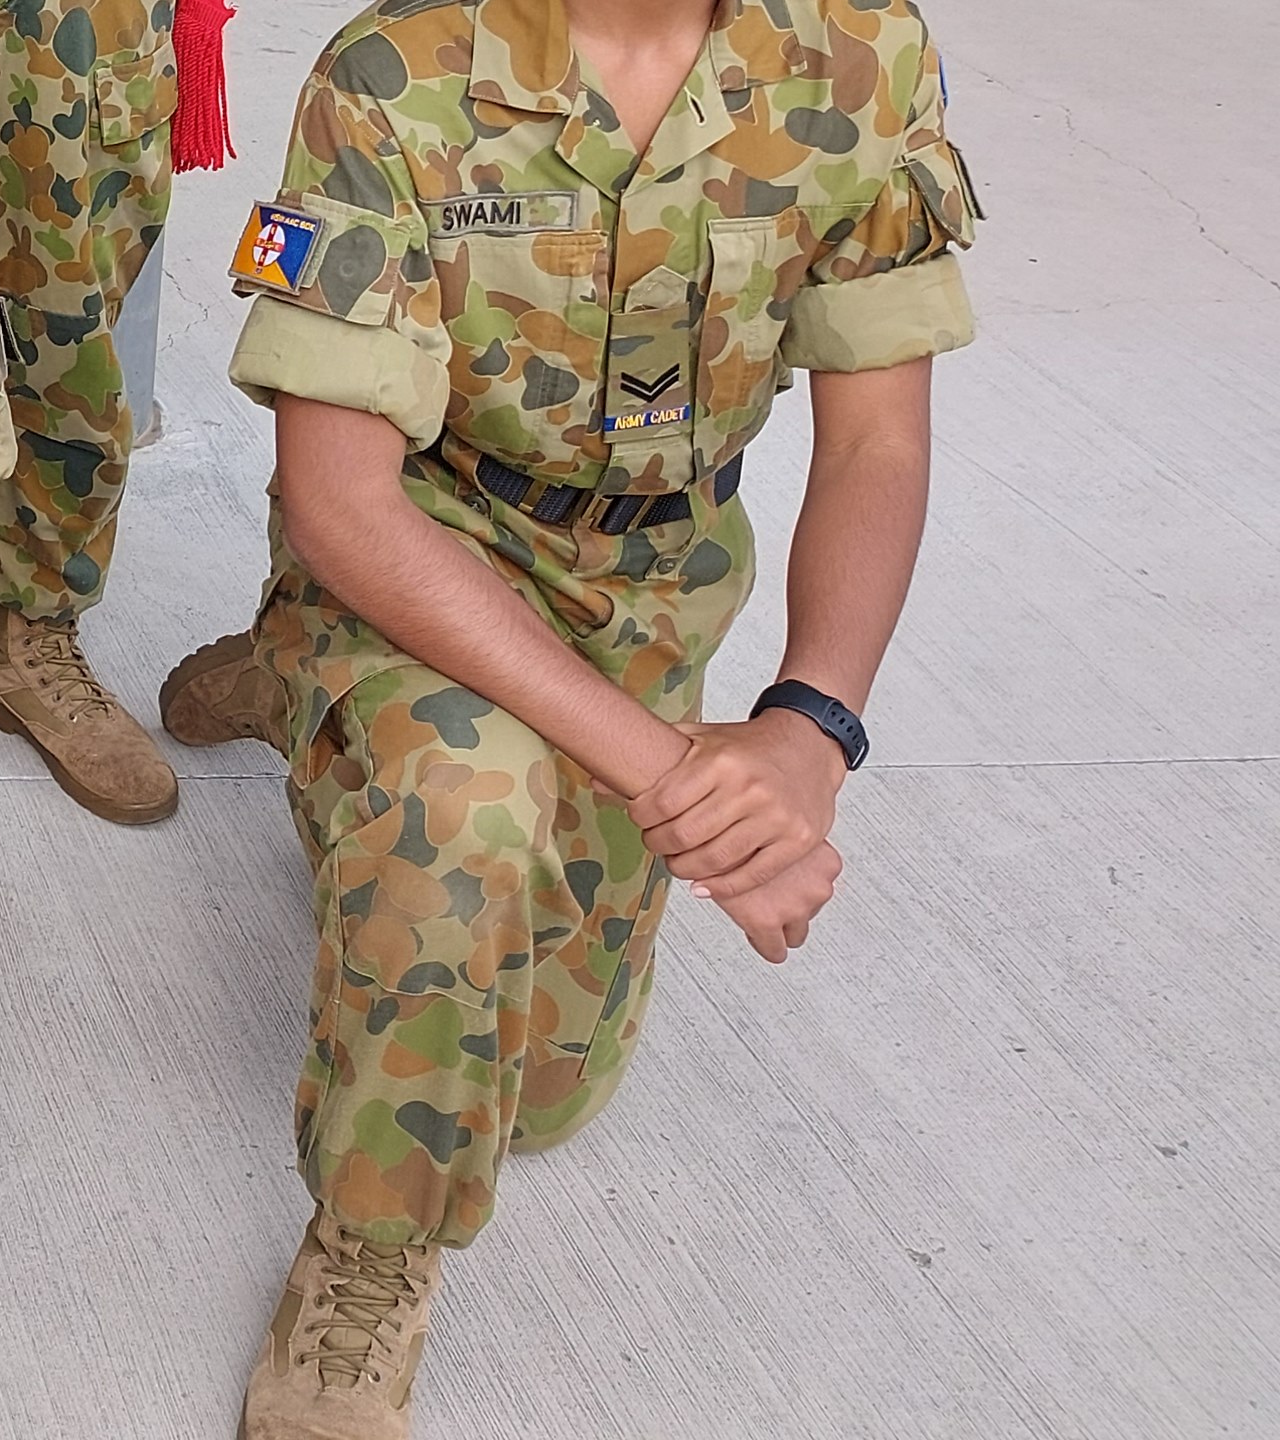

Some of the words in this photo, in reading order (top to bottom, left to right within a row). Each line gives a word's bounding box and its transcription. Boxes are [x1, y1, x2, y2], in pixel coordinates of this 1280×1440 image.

[441, 200, 521, 231] SWAMI
[614, 412, 646, 430] ARMY
[650, 407, 685, 424] CADET
